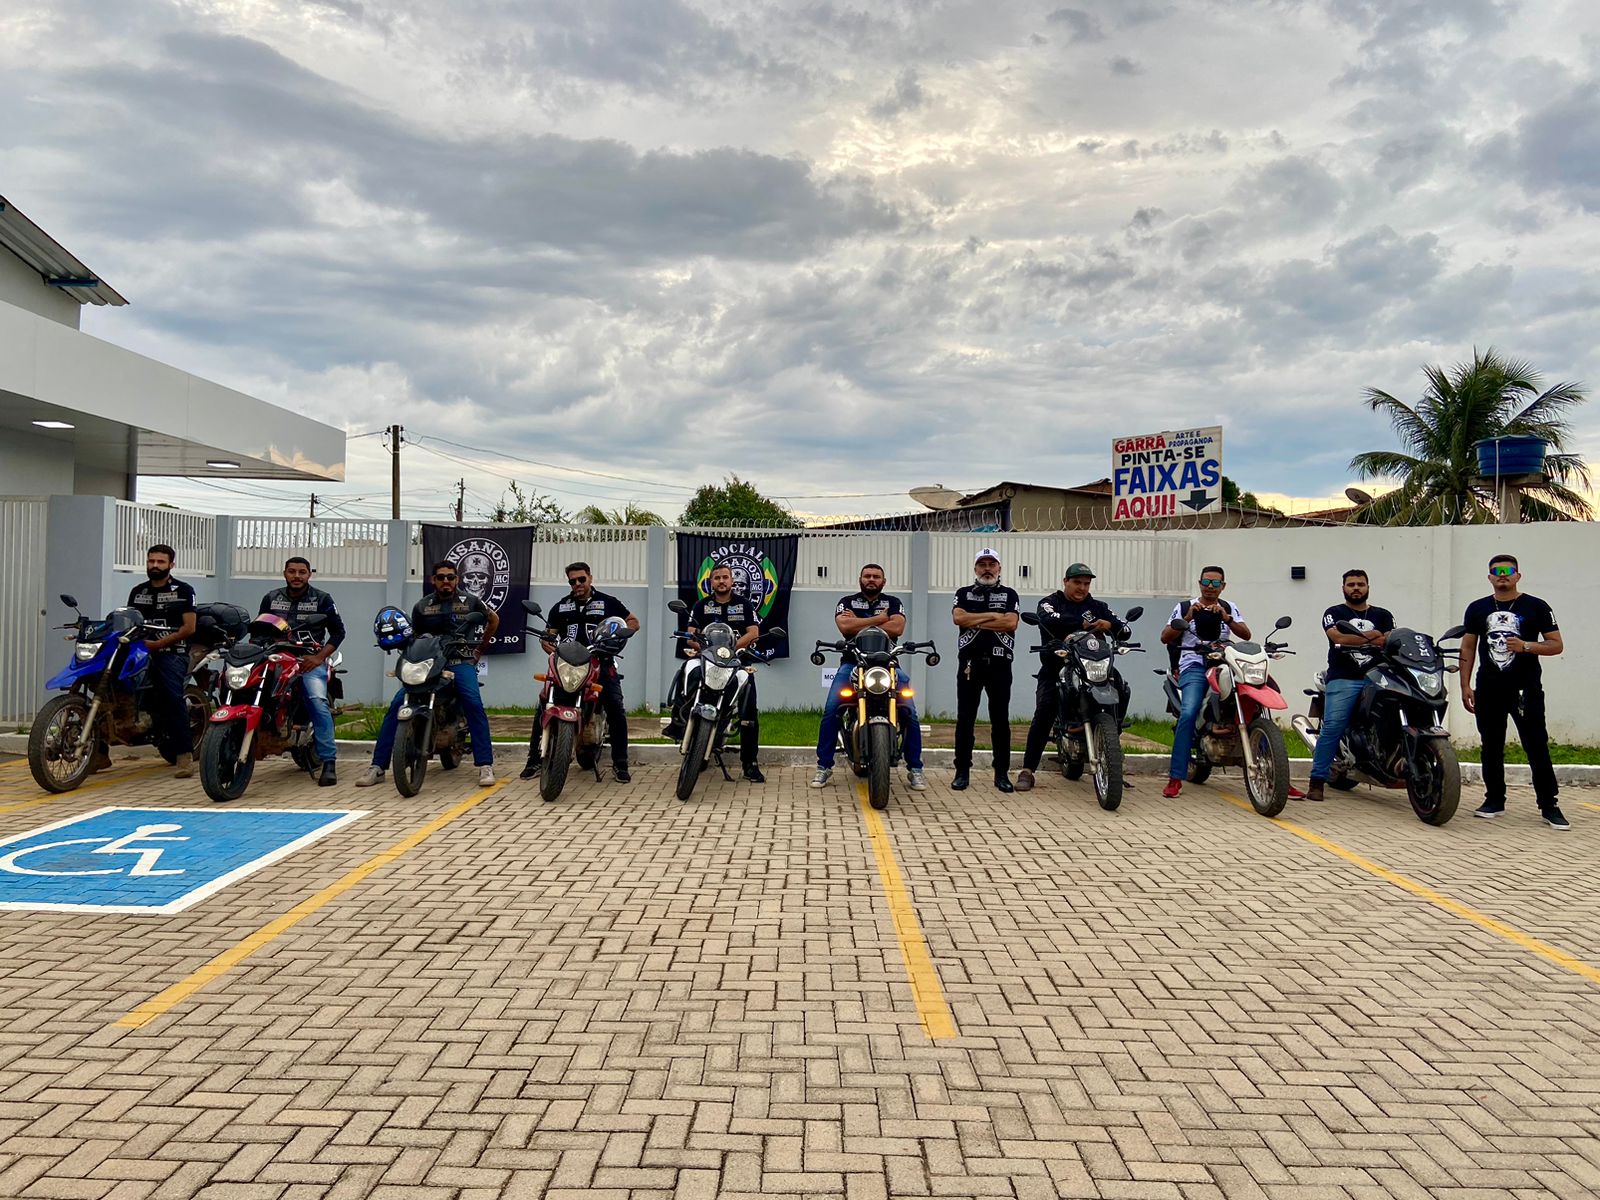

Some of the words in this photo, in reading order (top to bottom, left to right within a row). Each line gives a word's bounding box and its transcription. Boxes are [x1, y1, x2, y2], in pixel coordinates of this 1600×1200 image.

[1175, 431, 1195, 440] ARTE
[1196, 430, 1201, 438] E
[1114, 435, 1166, 454] GARRA
[1168, 436, 1213, 448] PROPAGANDA
[1121, 446, 1205, 466] PINTA-SE
[1114, 459, 1220, 497] FAIXAS
[447, 541, 507, 570] NSANOS
[710, 543, 763, 562] SOCIAL
[494, 574, 508, 584] MC
[751, 583, 762, 591] MC
[1323, 614, 1334, 625] 18
[504, 636, 519, 644] RO
